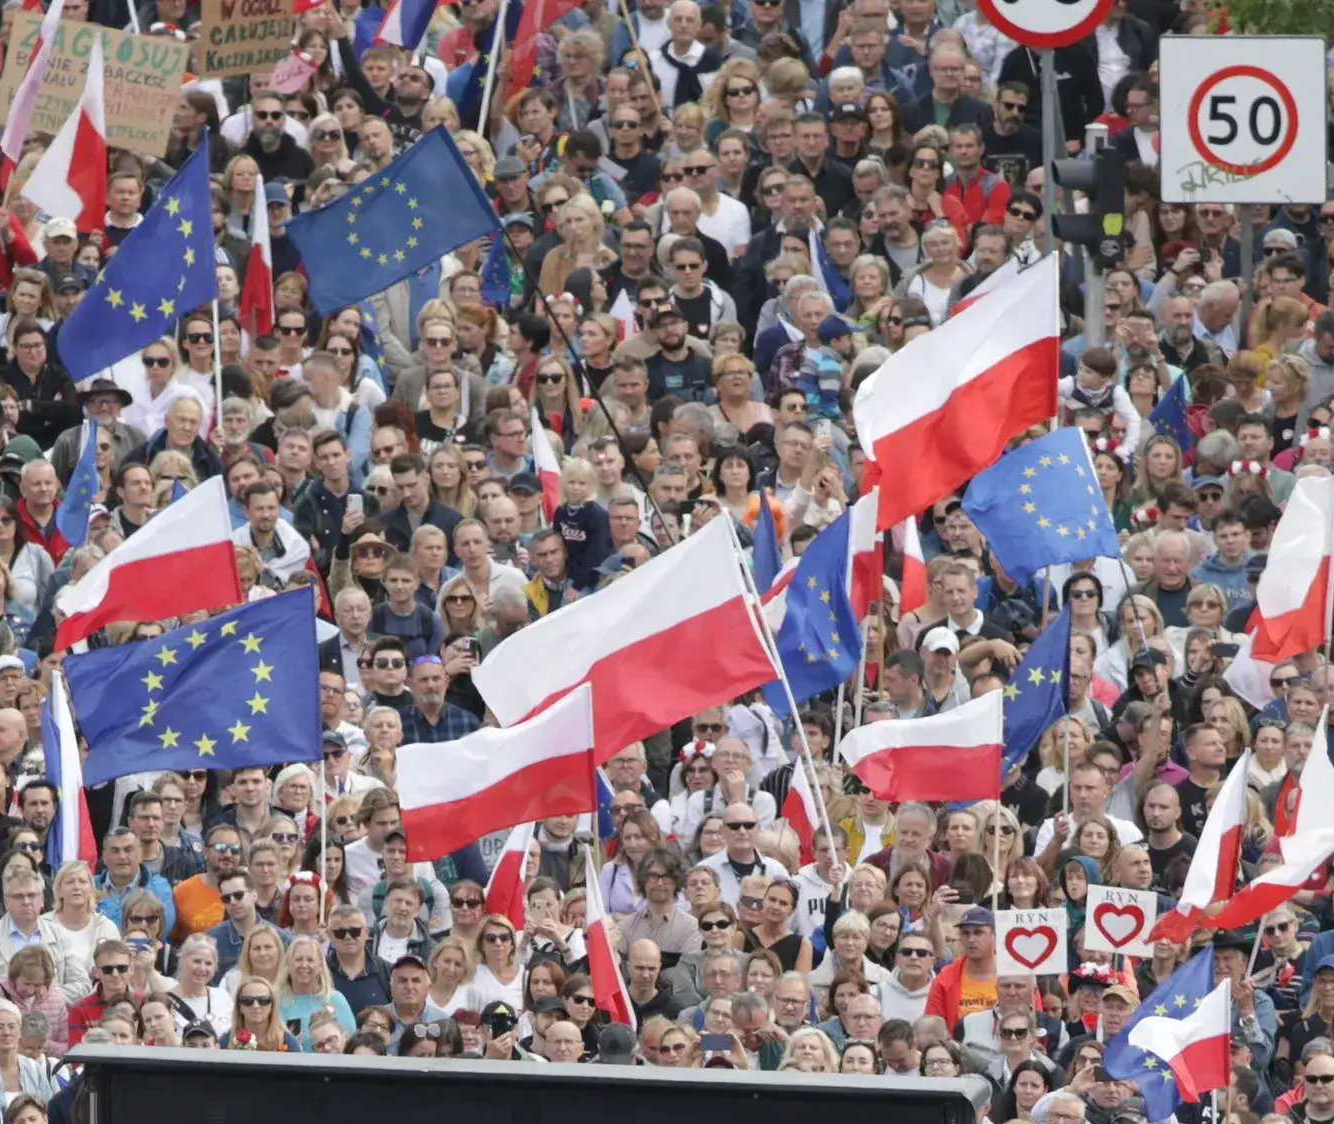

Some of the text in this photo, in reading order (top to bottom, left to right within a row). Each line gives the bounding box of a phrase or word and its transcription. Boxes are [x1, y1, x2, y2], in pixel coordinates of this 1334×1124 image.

[80, 62, 166, 89] ZBACZYSZ
[1207, 95, 1281, 146] 50
[1106, 890, 1138, 904] RYN
[1015, 913, 1048, 923] RYN
